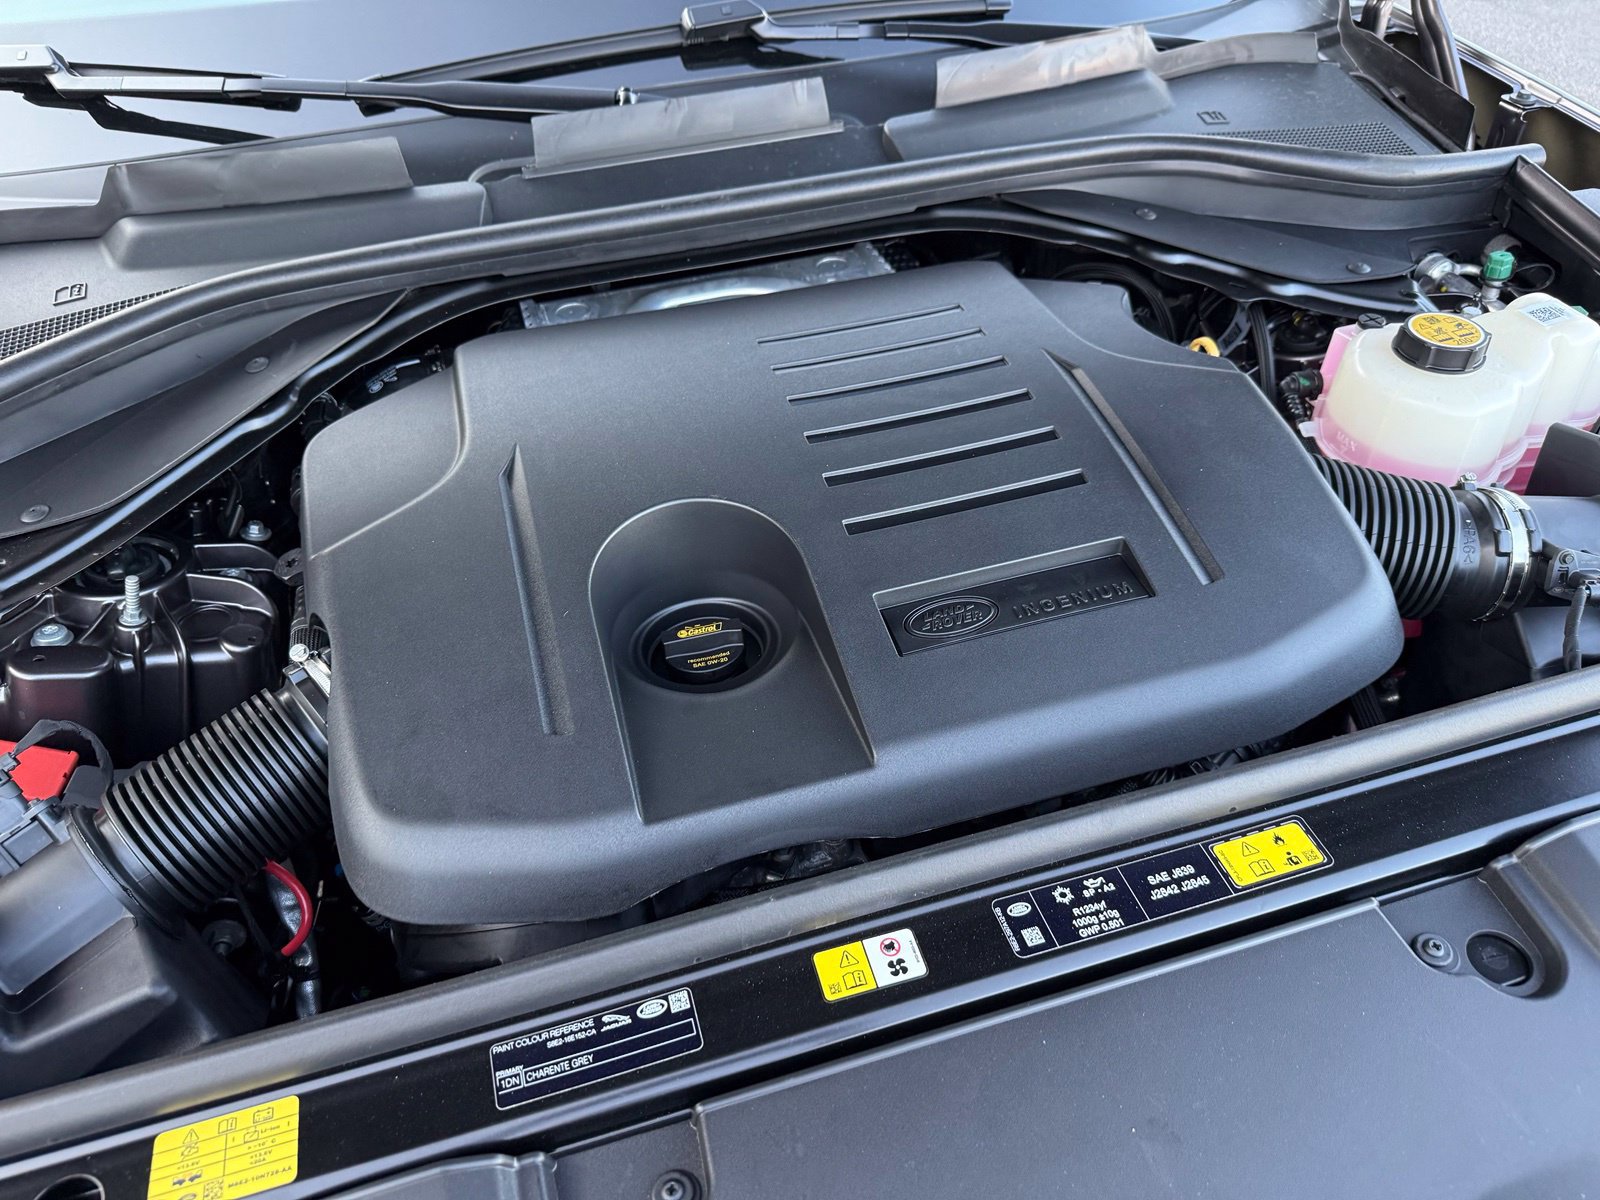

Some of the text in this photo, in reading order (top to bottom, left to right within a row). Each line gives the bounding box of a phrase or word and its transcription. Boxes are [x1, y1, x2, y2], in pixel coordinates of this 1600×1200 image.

[1012, 581, 1134, 619] INGENIUM
[923, 603, 966, 622] LAND
[931, 610, 984, 631] ROVER
[687, 623, 717, 636] Castrol
[687, 651, 730, 663] recommended
[707, 657, 728, 665] 0W-20
[1147, 864, 1196, 885] SAE J639
[1103, 882, 1116, 893] A2
[1150, 884, 1180, 900] J2842
[1072, 900, 1107, 917] R1234yf
[1072, 915, 1099, 928] 1000g
[1079, 917, 1125, 938] GWP 0.501
[492, 1018, 595, 1055] PAINT COLOUR REFERENCE
[495, 1064, 524, 1078] PRIMARY
[500, 1054, 594, 1088] 1DN CHARENTE GREY
